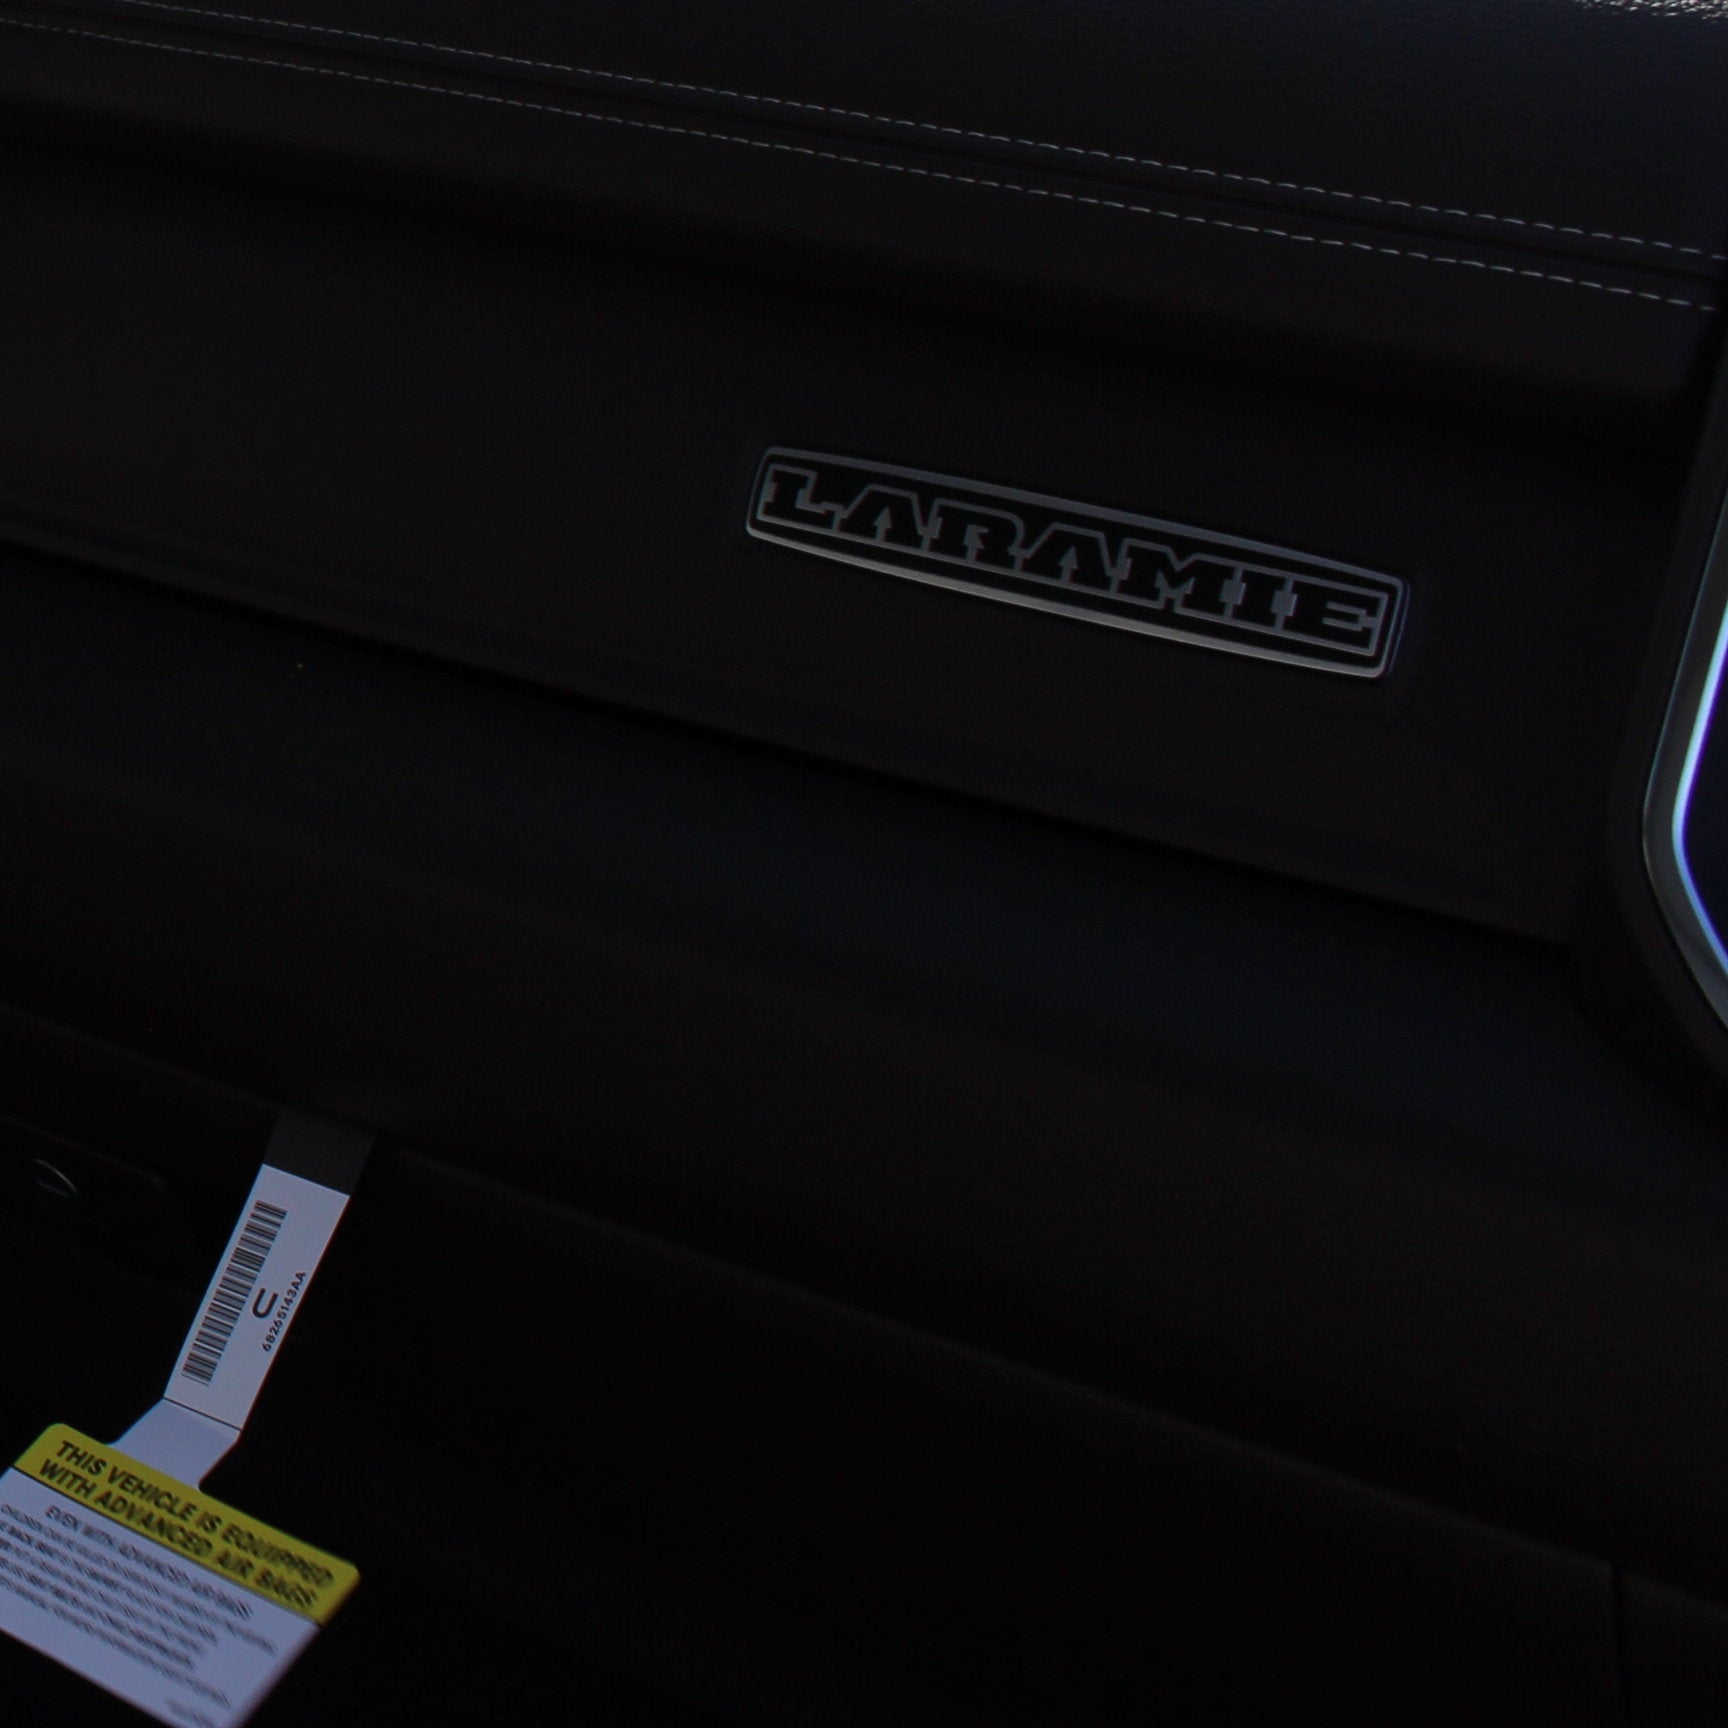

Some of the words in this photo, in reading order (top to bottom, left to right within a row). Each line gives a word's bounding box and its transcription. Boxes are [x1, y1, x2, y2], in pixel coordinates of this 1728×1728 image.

[760, 462, 1386, 656] LARAMIE
[262, 1270, 307, 1353] 68265143AA
[39, 1458, 98, 1501] WITH
[98, 1490, 213, 1559] ADVANCED
[56, 1440, 106, 1475] THIS
[108, 1466, 196, 1522] VEHICLE
[197, 1510, 222, 1534] IS
[221, 1519, 335, 1588] EQUIPPED
